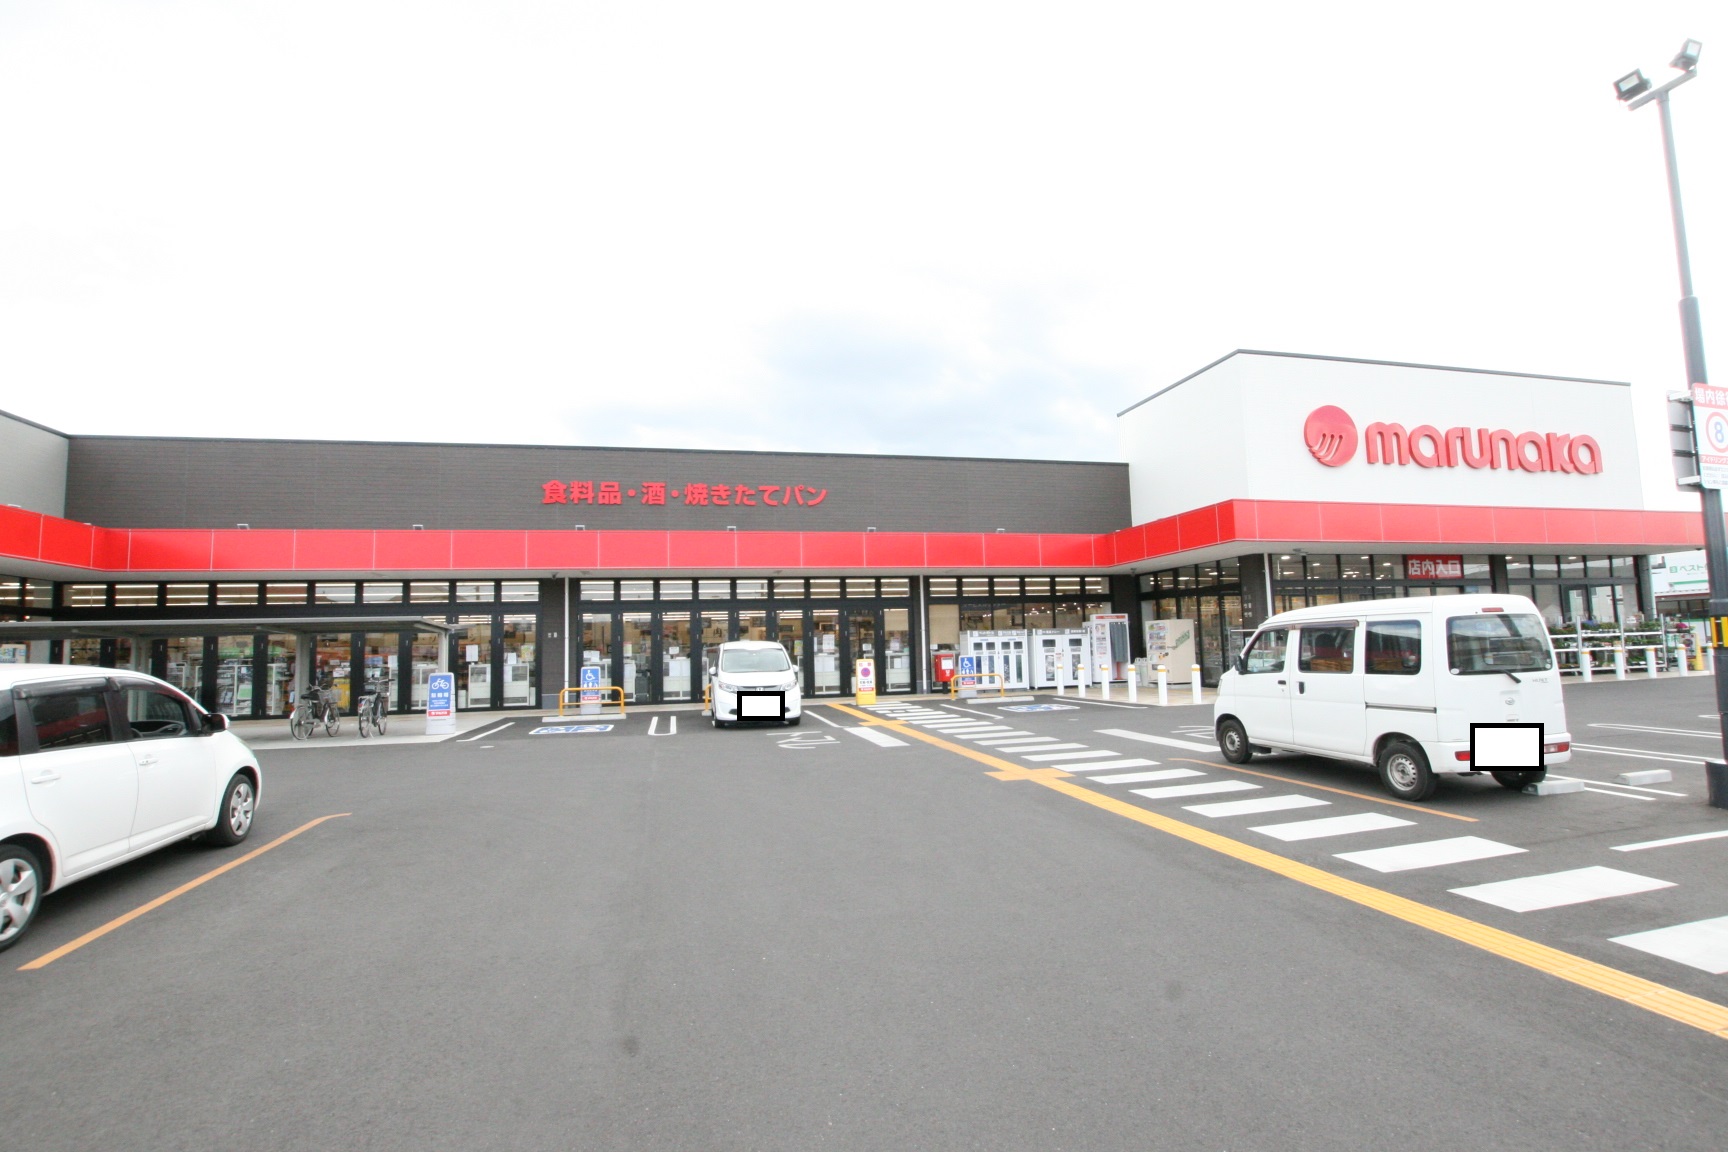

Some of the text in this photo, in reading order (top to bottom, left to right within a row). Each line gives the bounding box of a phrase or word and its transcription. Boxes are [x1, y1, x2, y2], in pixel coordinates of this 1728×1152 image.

[1695, 387, 1728, 408] 場内徐
[1714, 421, 1725, 443] 8
[1365, 421, 1604, 475] marunaka
[541, 479, 828, 507] 食料品・酒・焼きたてパン
[1408, 559, 1462, 576] 店内入口
